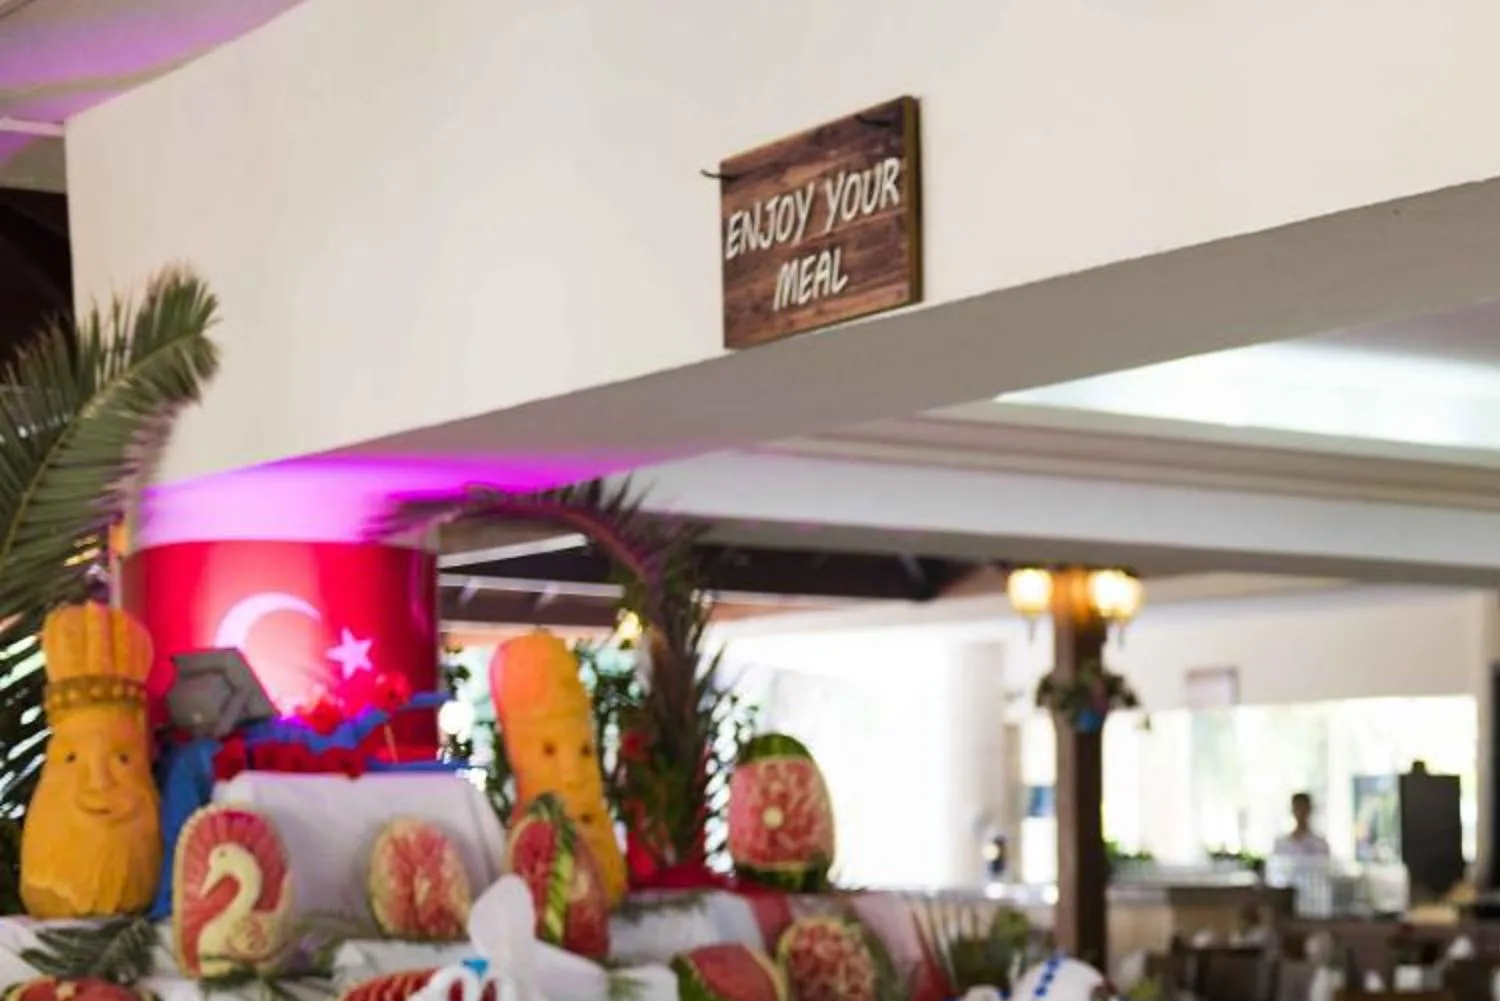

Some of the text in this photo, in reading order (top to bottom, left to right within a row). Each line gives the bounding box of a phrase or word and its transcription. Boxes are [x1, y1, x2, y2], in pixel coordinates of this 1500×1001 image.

[726, 157, 901, 260] ENJOY YOUR
[773, 246, 849, 312] MEAL
